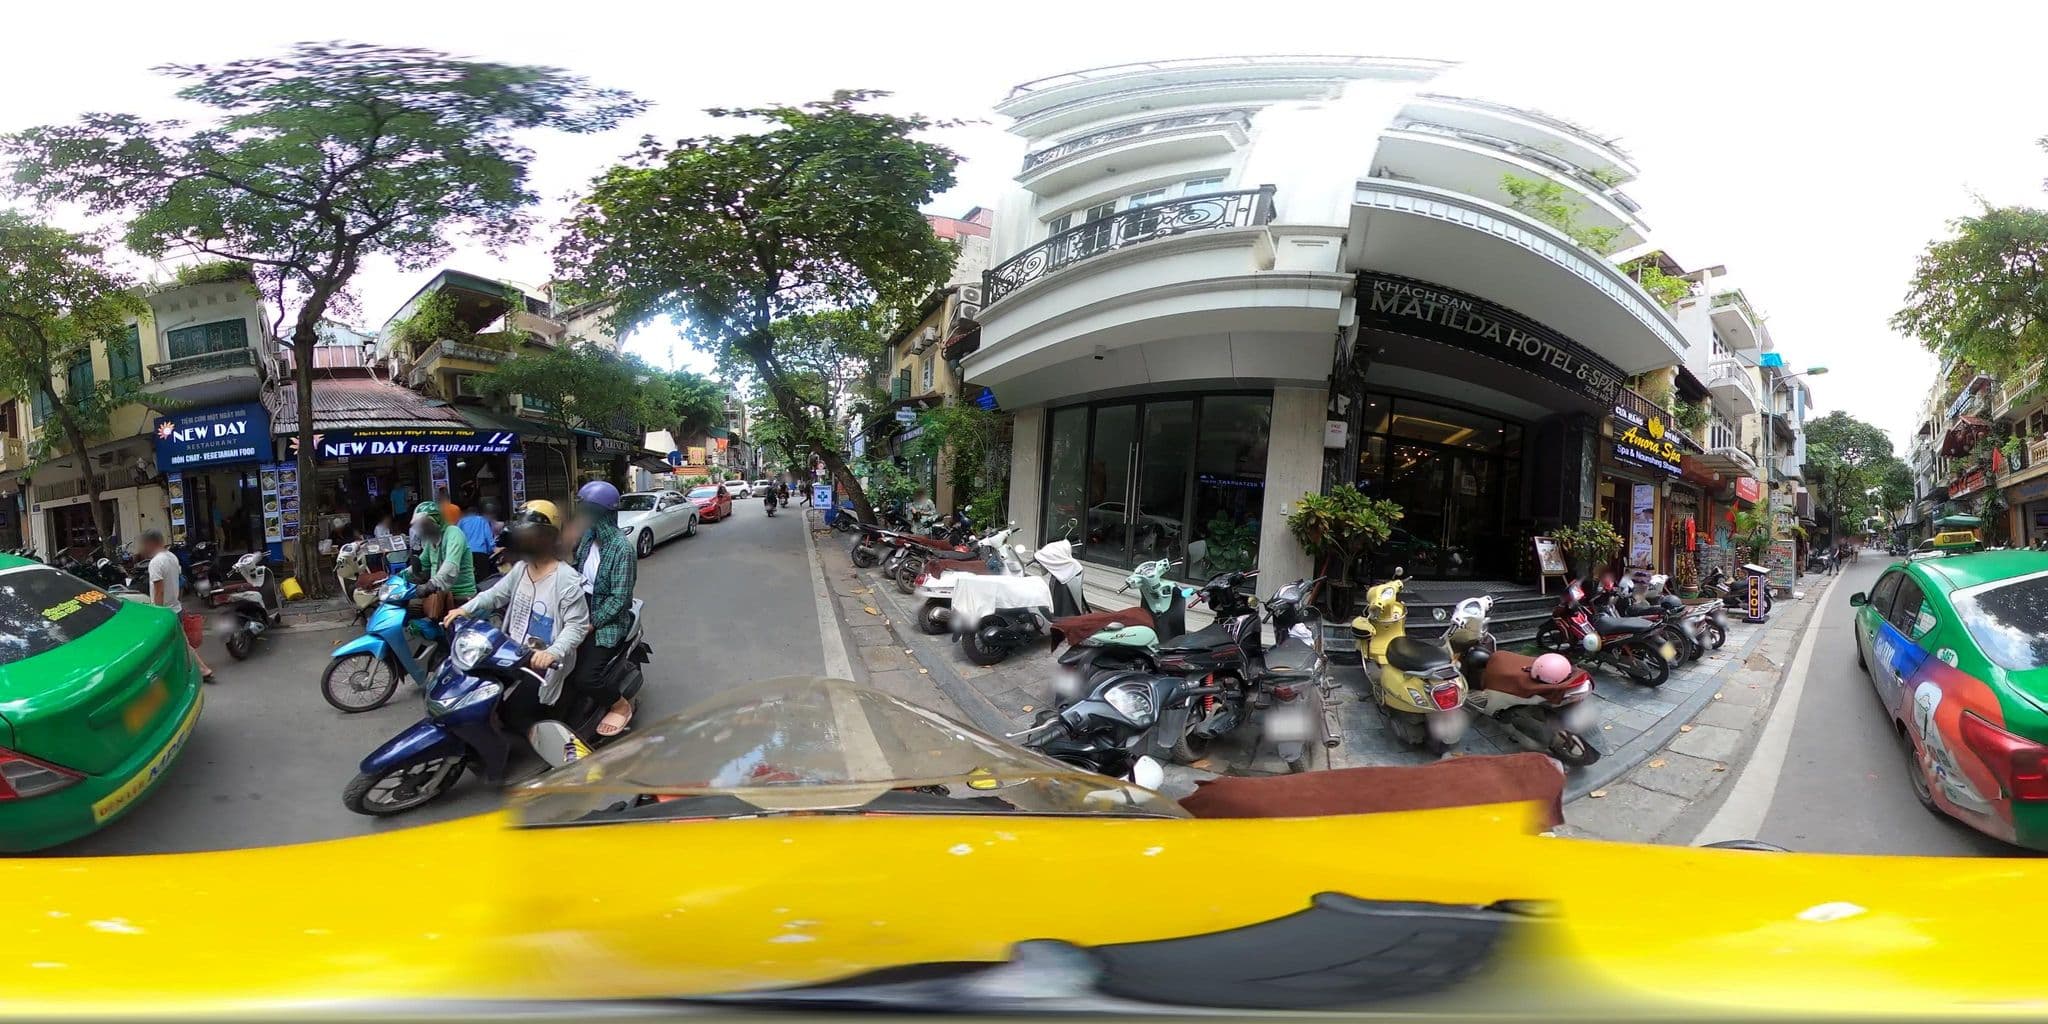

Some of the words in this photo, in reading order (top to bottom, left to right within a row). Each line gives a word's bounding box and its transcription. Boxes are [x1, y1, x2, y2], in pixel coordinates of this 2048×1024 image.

[1373, 280, 1438, 301] KHÁCH
[1369, 290, 1502, 343] MATILDA
[1505, 328, 1573, 374] HOTEL
[1576, 363, 1589, 380] &
[1588, 369, 1615, 398] SPA
[173, 425, 209, 443] NEW
[214, 420, 248, 437] DAY
[186, 439, 238, 450] RESTAURANT
[203, 449, 239, 460] VEGETARIAN
[240, 447, 255, 457] FOOD
[325, 442, 367, 457] NEW
[371, 441, 408, 454] DAY
[410, 444, 481, 453] RESTAURANT
[1621, 427, 1660, 454] Amora
[1661, 442, 1681, 463] Spa
[1750, 578, 1759, 616] FOOT
